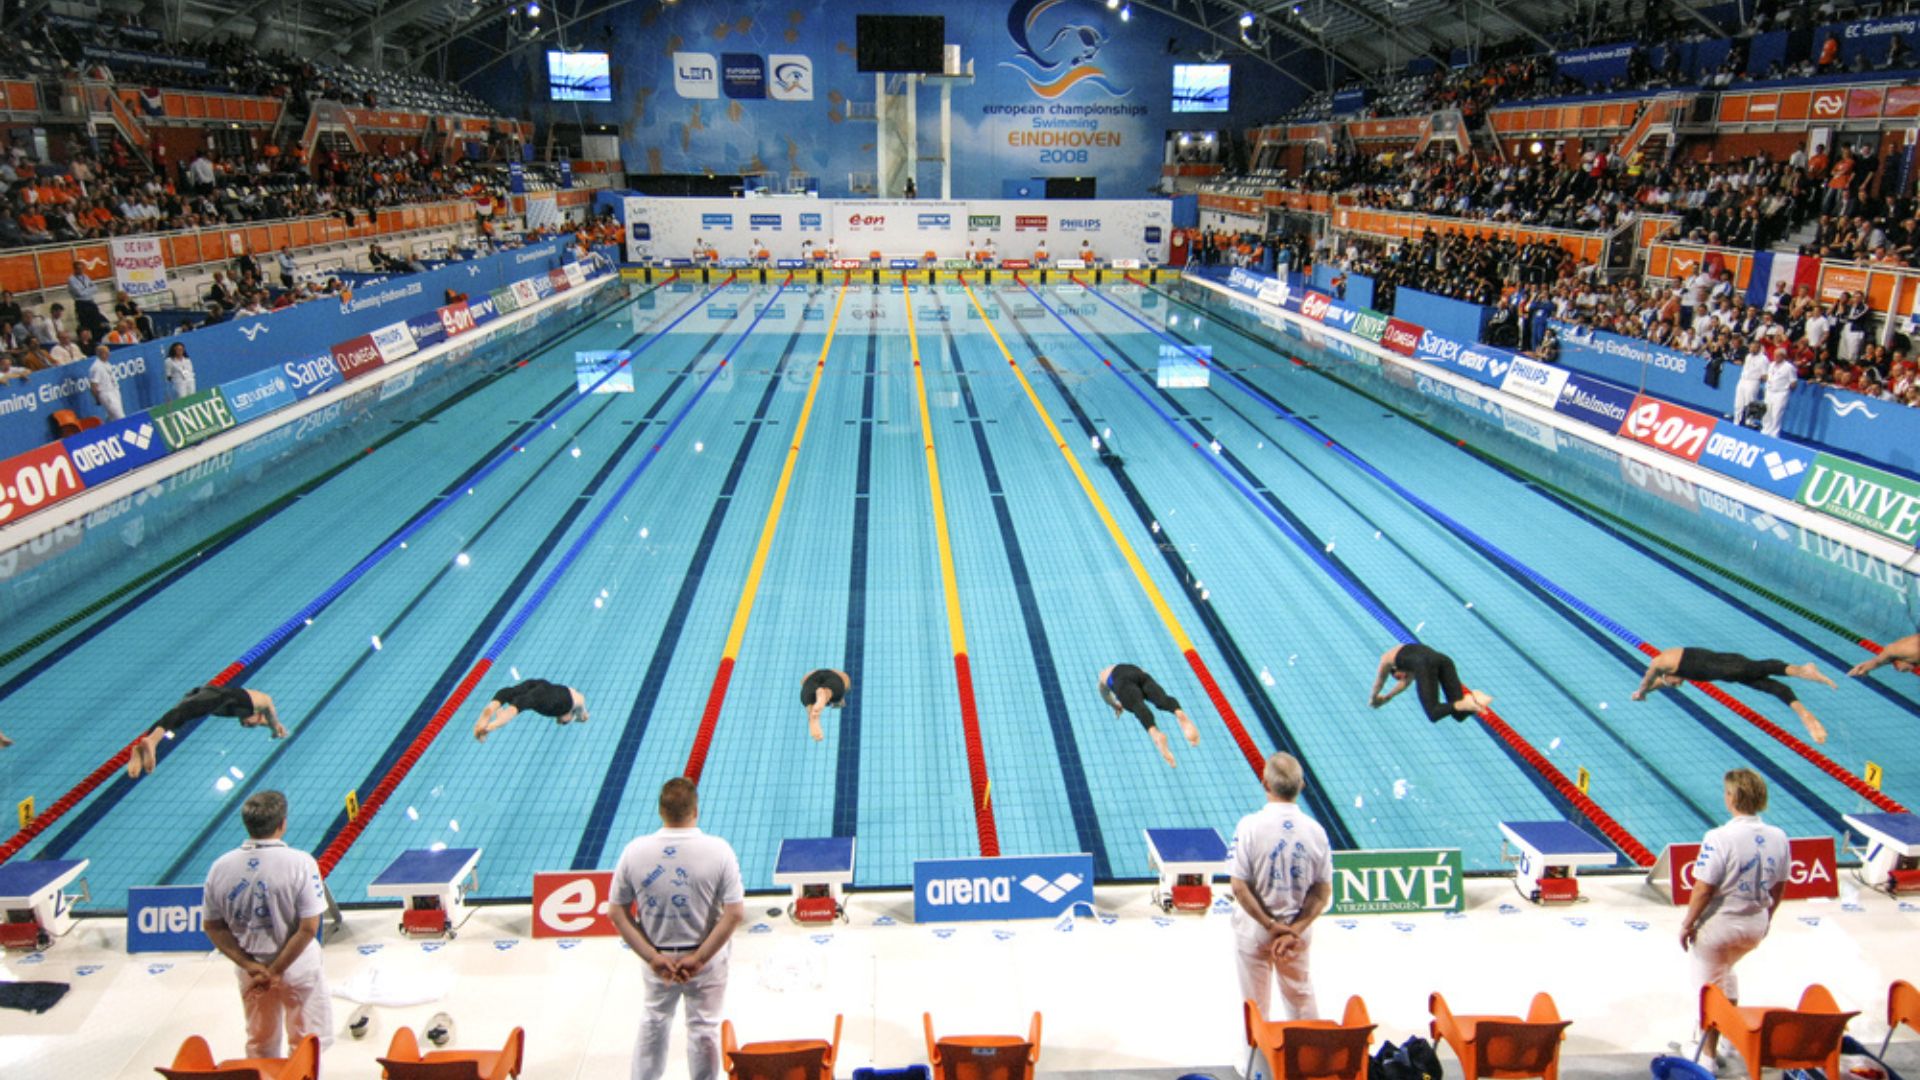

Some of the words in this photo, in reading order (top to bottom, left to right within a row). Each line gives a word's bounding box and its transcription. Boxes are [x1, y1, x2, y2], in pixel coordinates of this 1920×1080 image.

[982, 104, 1045, 115] european
[1049, 102, 1149, 116] championships
[1032, 118, 1098, 130] Swimming
[1008, 131, 1121, 147] EINDHOVEN
[1040, 150, 1088, 163] 2008
[1060, 219, 1101, 228] PHILIPS
[1418, 330, 1462, 361] Sanex
[284, 353, 339, 389] Sanex
[1510, 361, 1549, 385] PHILIPS
[1654, 352, 1687, 373] 2008
[72, 436, 126, 473] arena
[1706, 432, 1760, 468] arena
[926, 876, 1010, 905] arena
[1332, 852, 1458, 910] NIVÉ
[138, 905, 206, 934] aren
